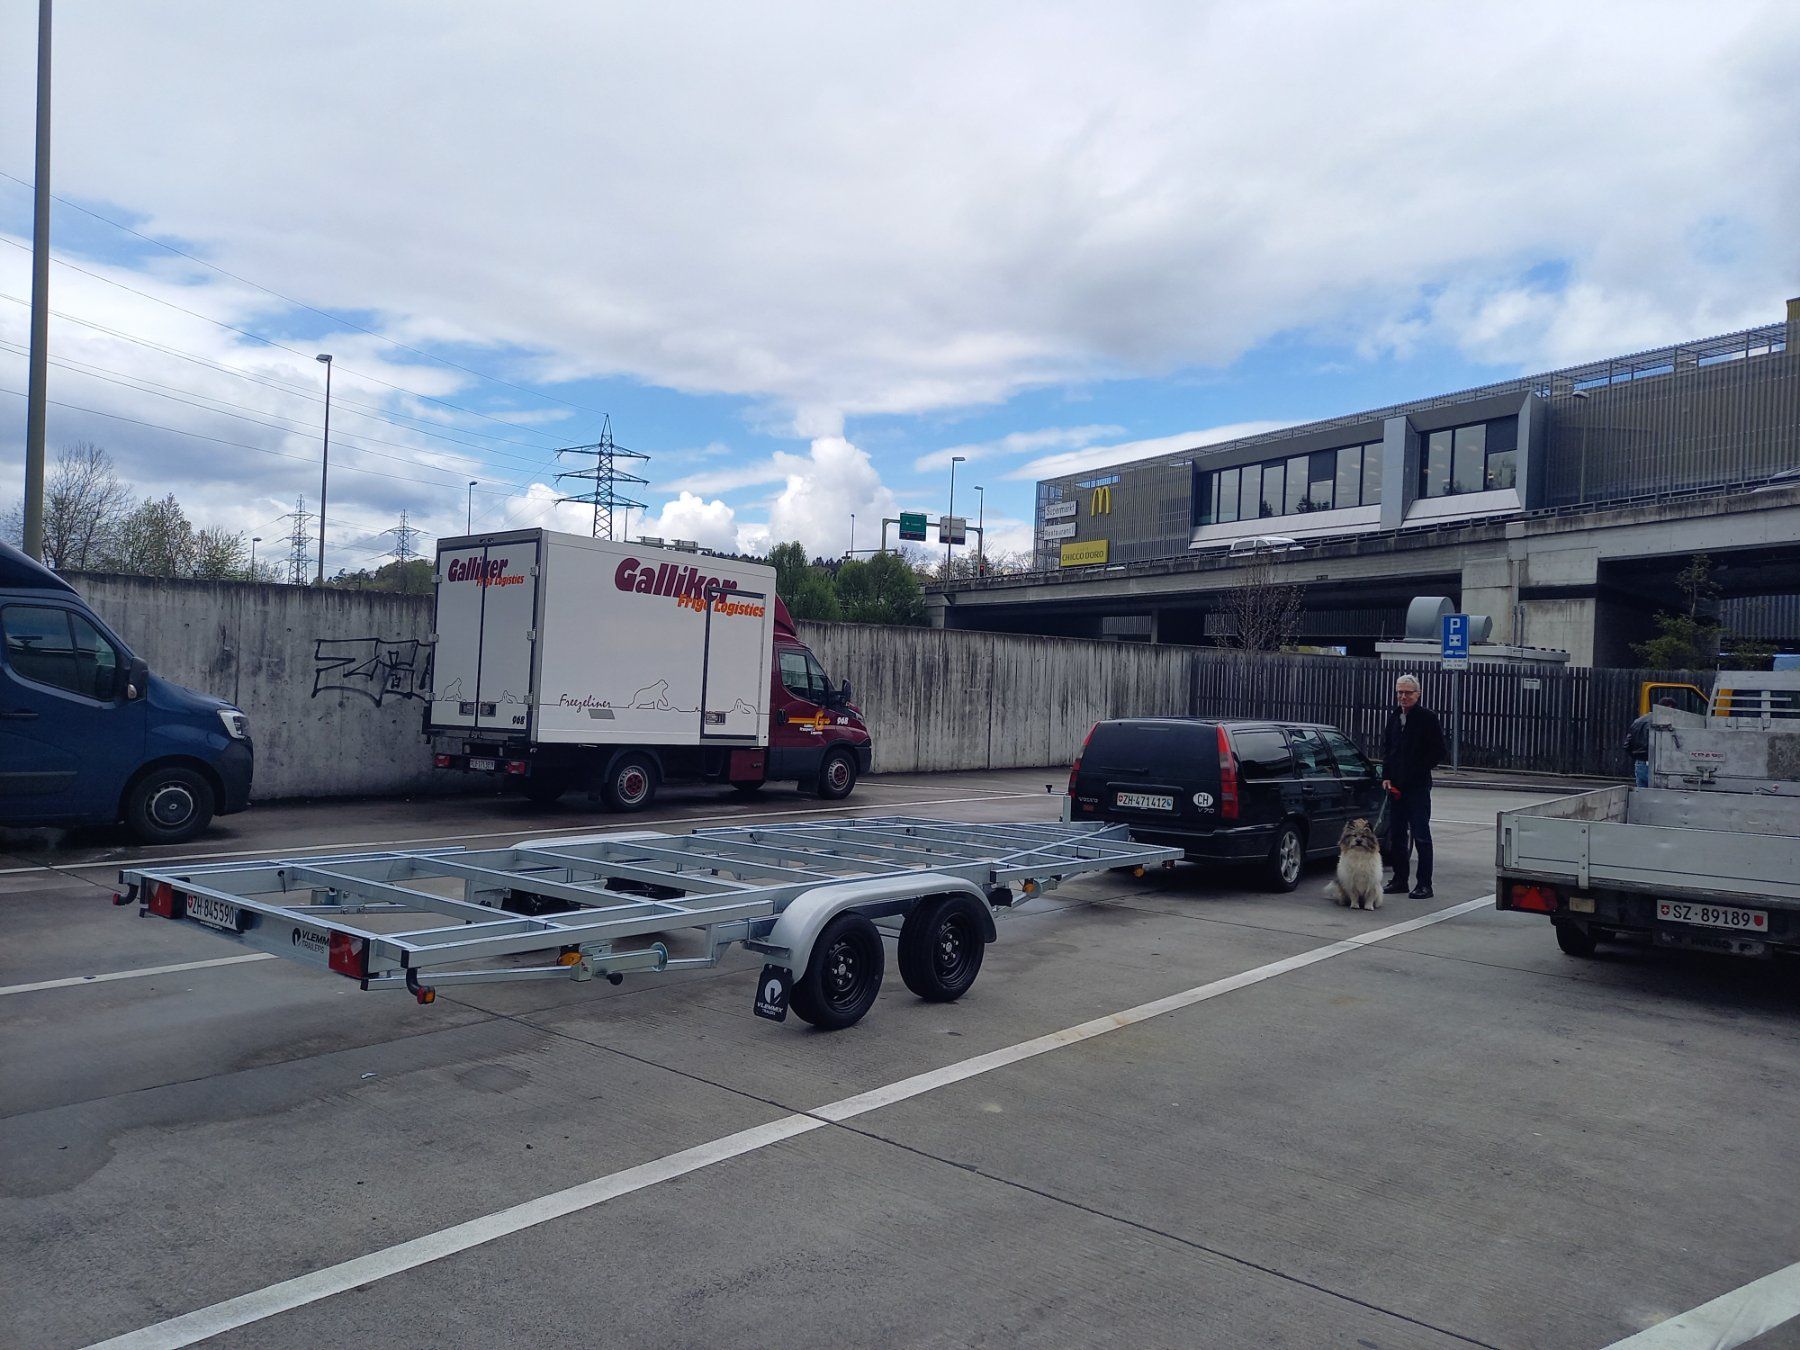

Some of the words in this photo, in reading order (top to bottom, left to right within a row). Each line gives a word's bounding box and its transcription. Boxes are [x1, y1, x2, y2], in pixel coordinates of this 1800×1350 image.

[614, 557, 737, 603] Galliker
[713, 597, 765, 618] Logistics
[1450, 618, 1461, 634] P
[1197, 794, 1209, 805] CH
[302, 930, 330, 946] VLEMM
